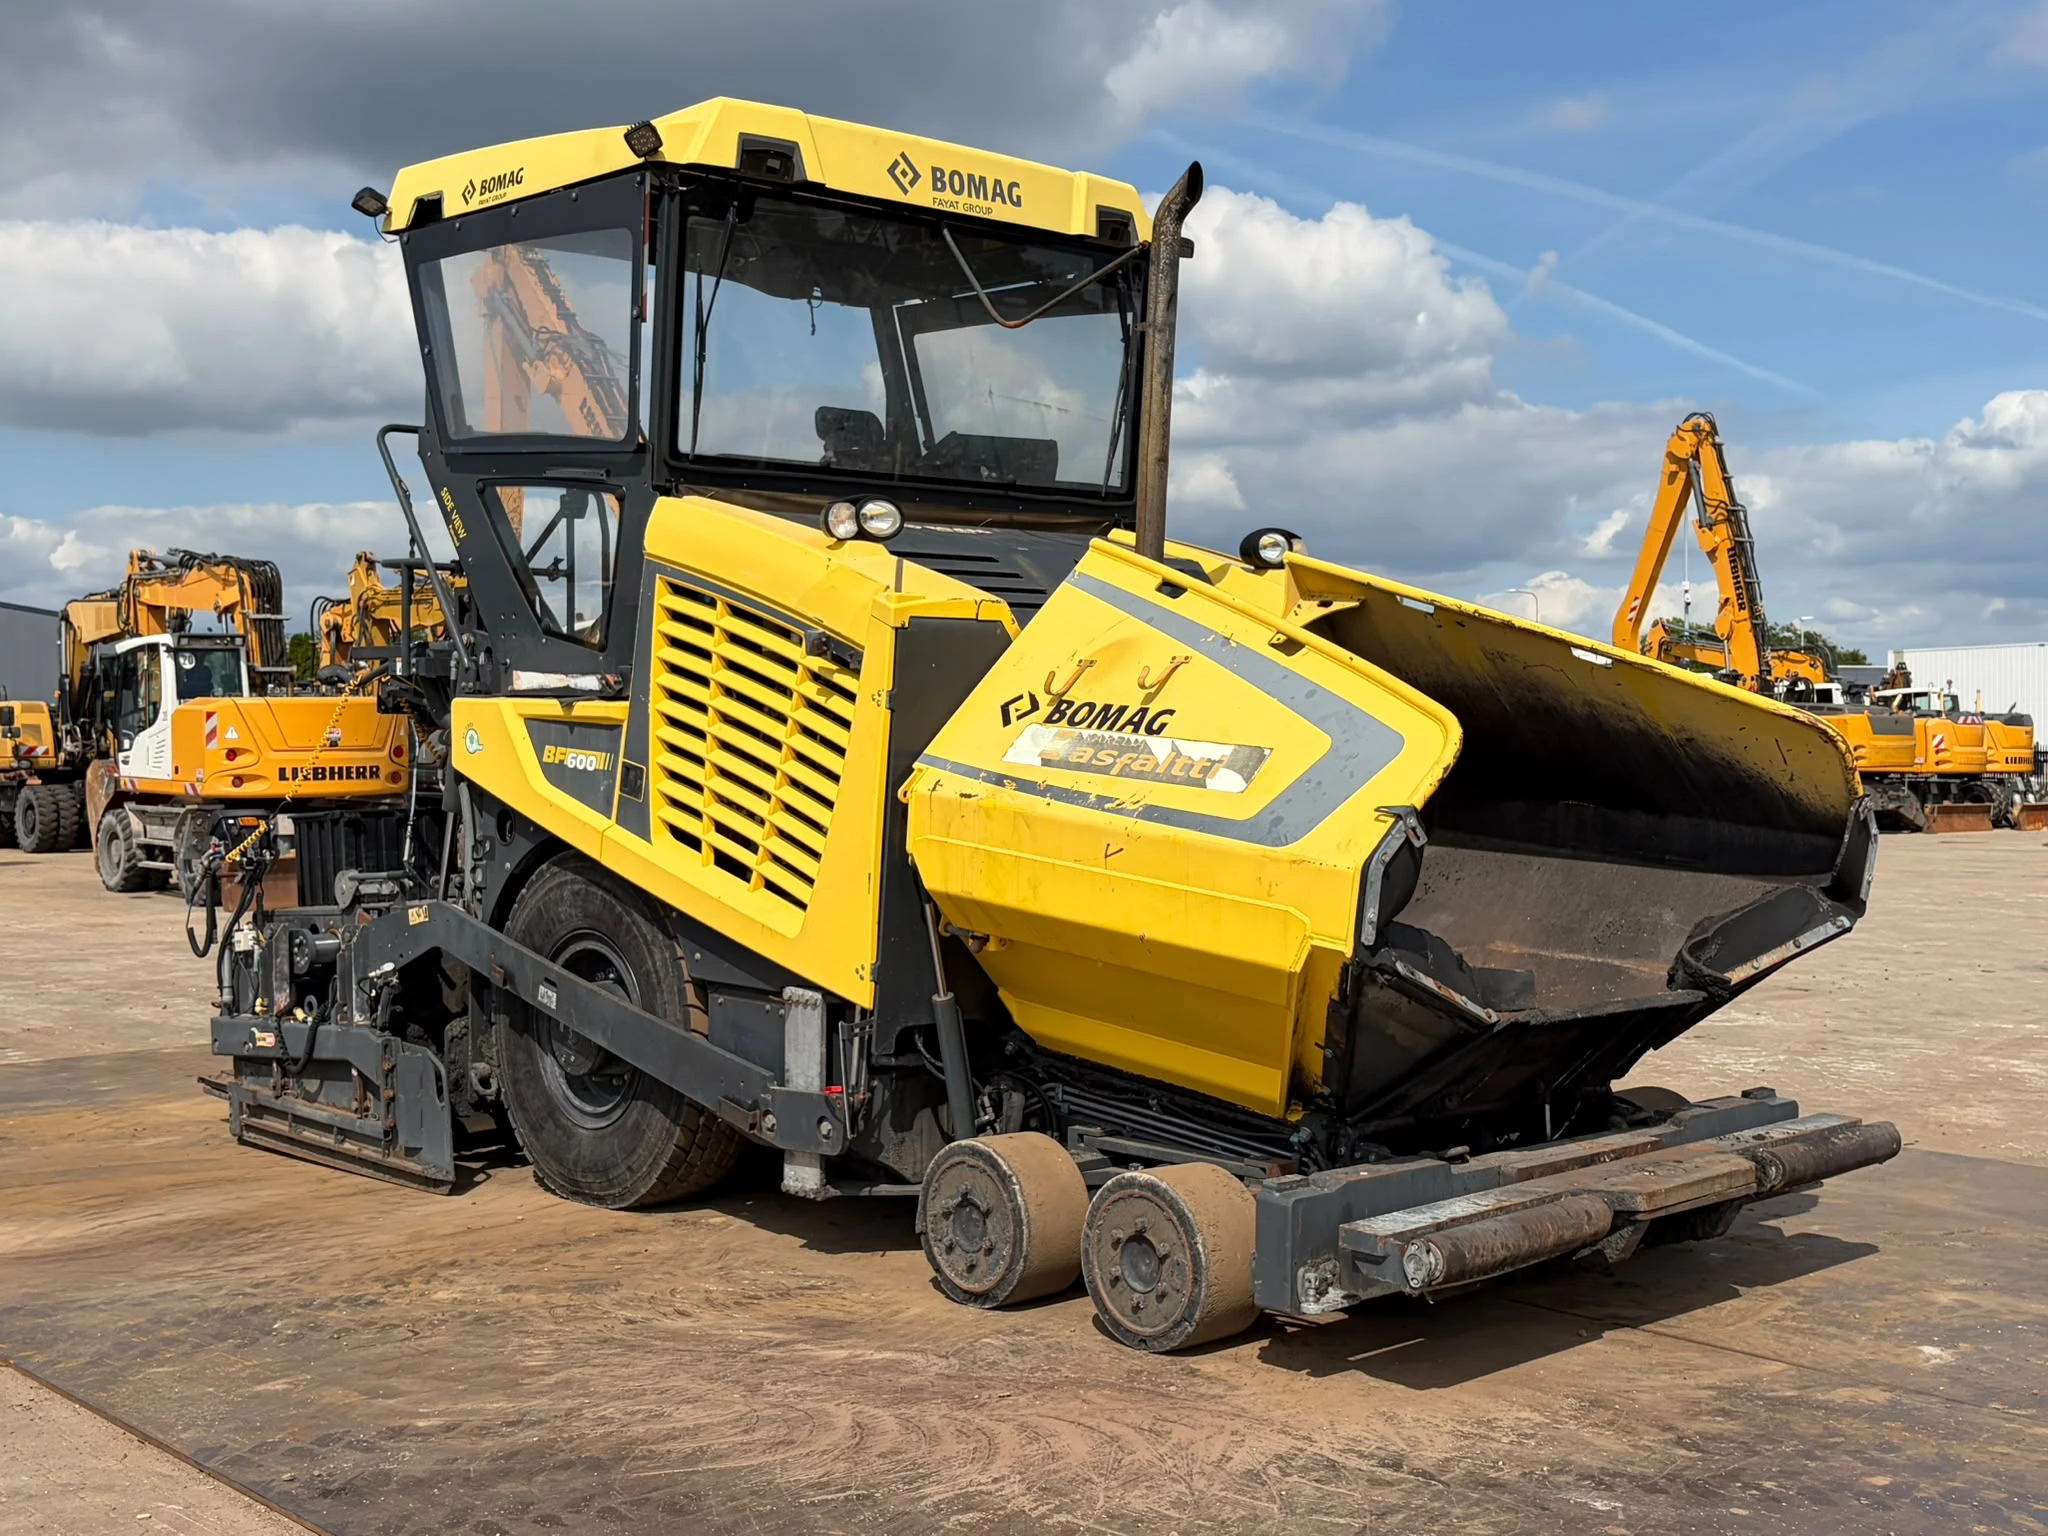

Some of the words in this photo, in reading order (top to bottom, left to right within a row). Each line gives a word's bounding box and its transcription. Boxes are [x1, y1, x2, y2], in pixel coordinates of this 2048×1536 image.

[479, 166, 524, 196] BOMAG
[931, 165, 1023, 208] BOMAG
[932, 197, 959, 211] FAYAT
[962, 203, 993, 216] GROUP
[440, 487, 455, 512] SIDE
[451, 509, 467, 538] VIEW
[1043, 699, 1177, 735] BOMAG
[278, 765, 380, 781] LIEBHERR
[1067, 746, 1230, 779] asfaltti
